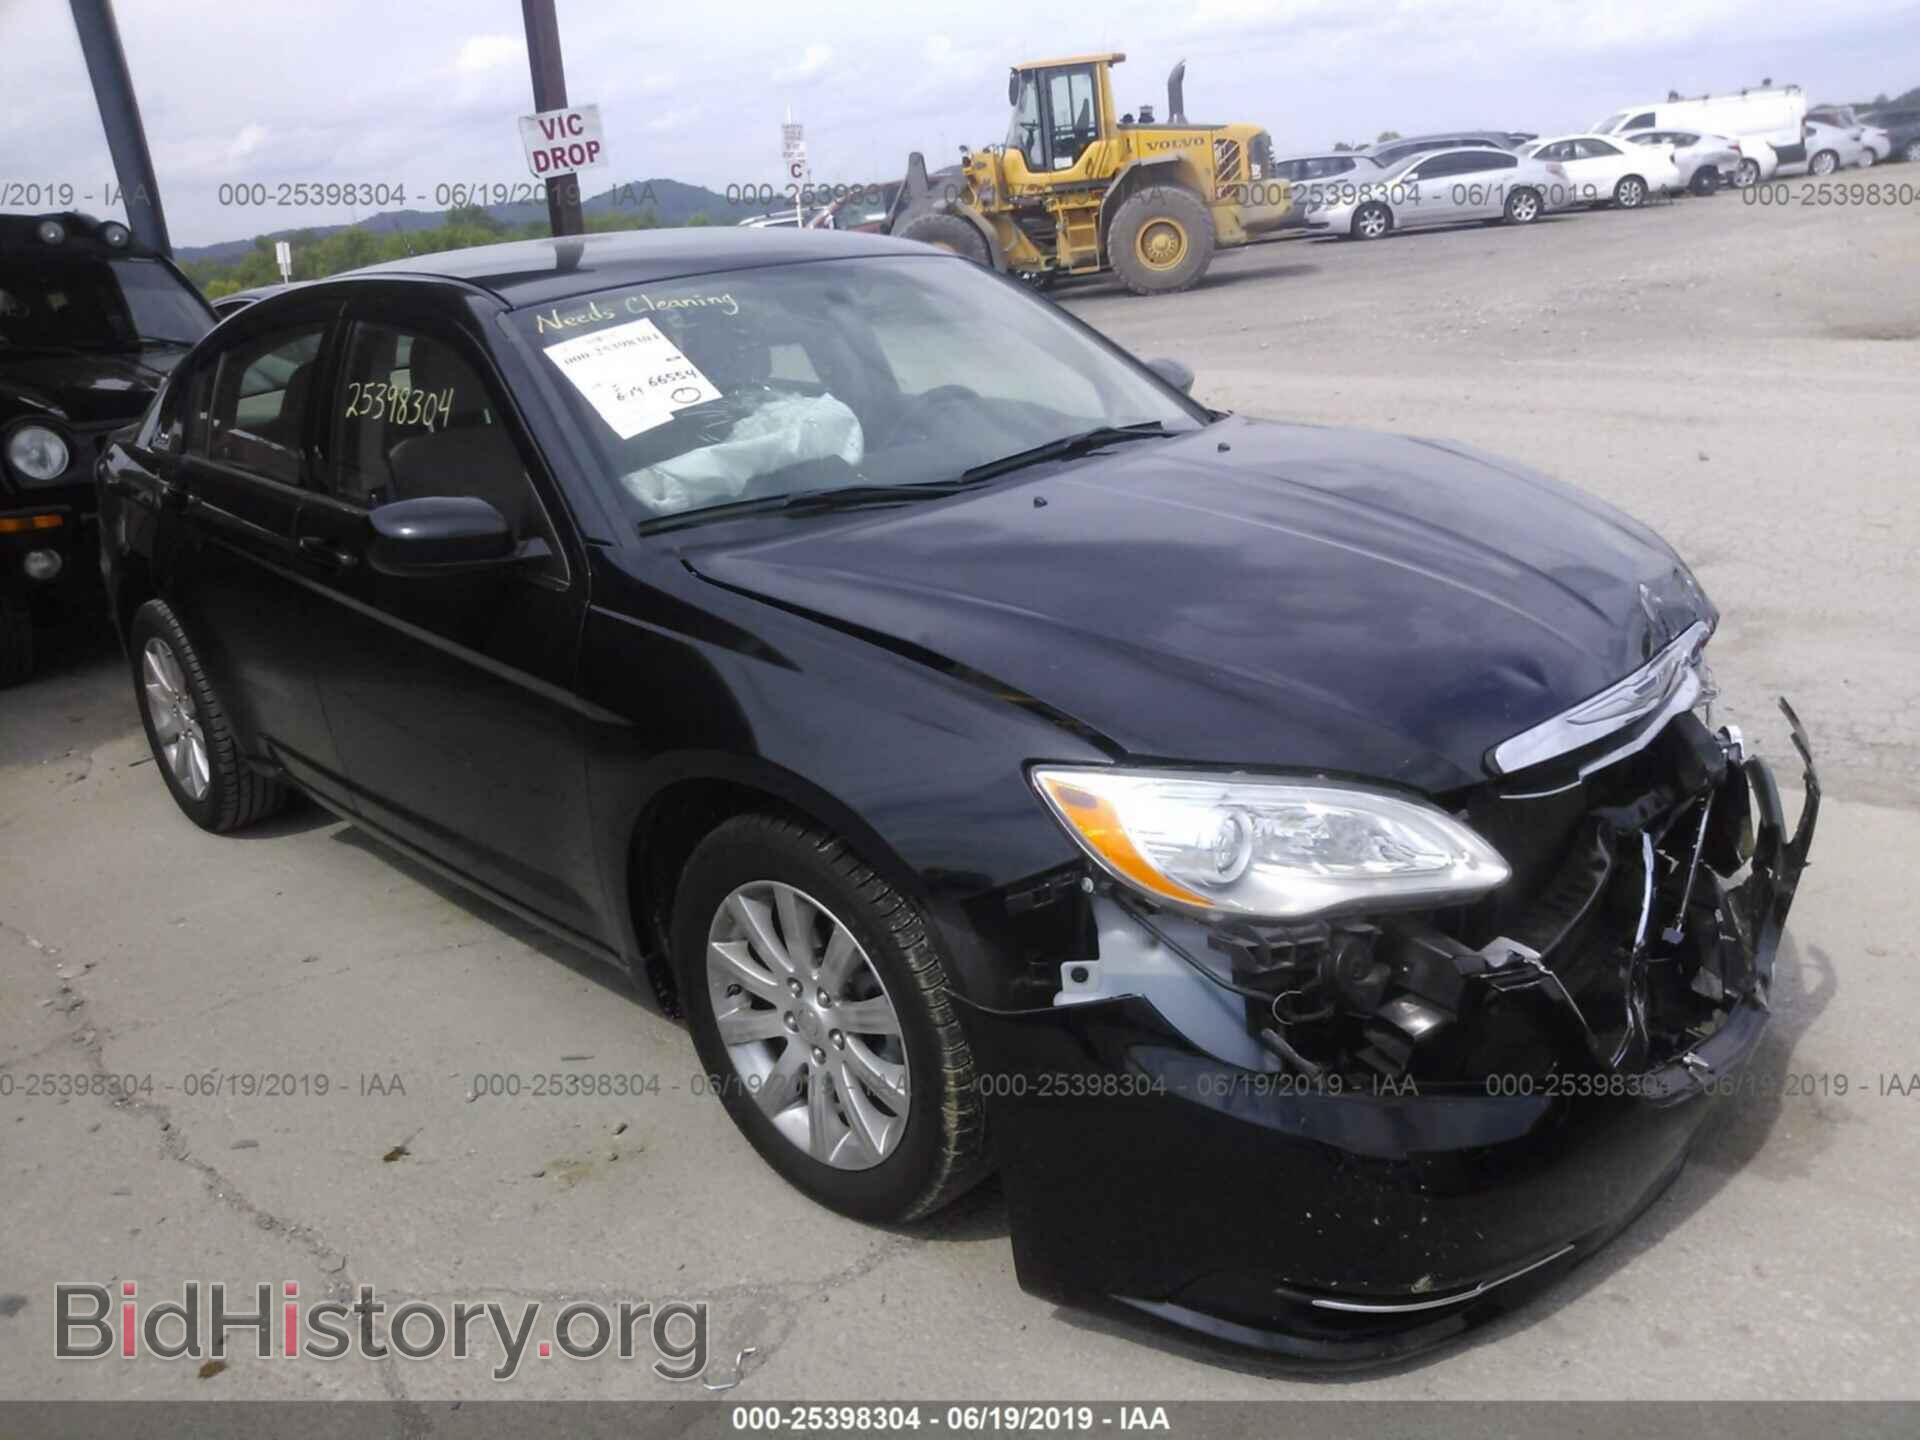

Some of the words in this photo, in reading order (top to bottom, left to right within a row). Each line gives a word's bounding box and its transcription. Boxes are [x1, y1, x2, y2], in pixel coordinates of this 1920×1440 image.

[539, 113, 584, 141] VIC
[532, 140, 600, 173] DROP
[1146, 137, 1205, 151] VOLVO
[791, 163, 803, 179] C
[536, 302, 615, 334] Needs
[625, 293, 739, 316] Cleaning
[345, 382, 454, 433] 25398304
